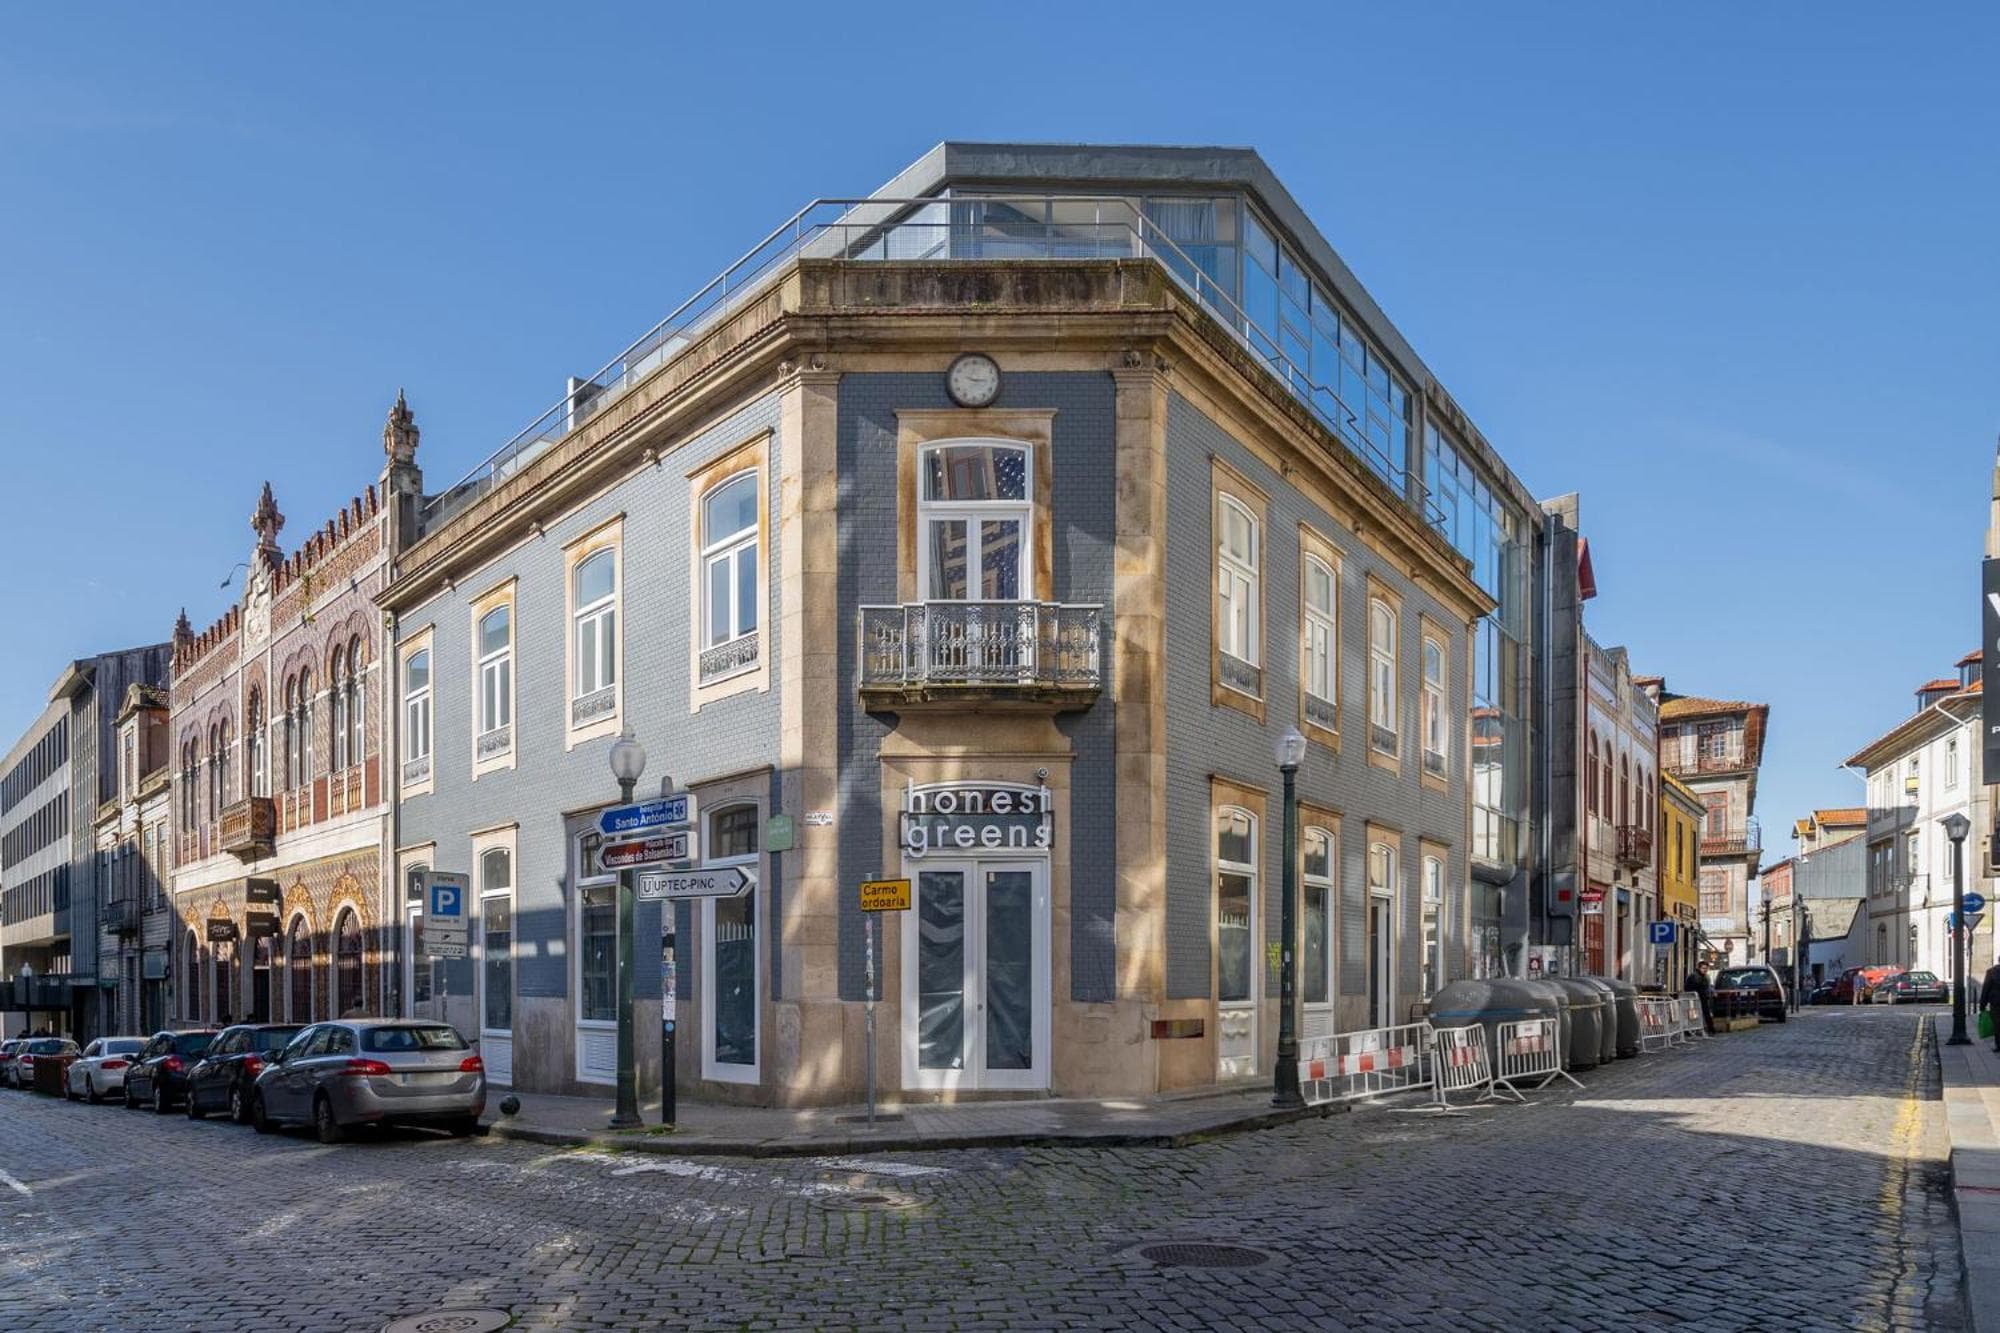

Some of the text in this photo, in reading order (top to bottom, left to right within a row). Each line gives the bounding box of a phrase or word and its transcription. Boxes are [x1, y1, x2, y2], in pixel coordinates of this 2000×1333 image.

[908, 777, 1050, 814] honest
[615, 811, 673, 830] Santo António
[907, 824, 1051, 857] greens
[635, 852, 643, 862] de
[654, 878, 714, 891] UPTEC-PINC
[863, 885, 897, 896] Carmo
[438, 889, 455, 913] P
[1655, 924, 1670, 942] P
